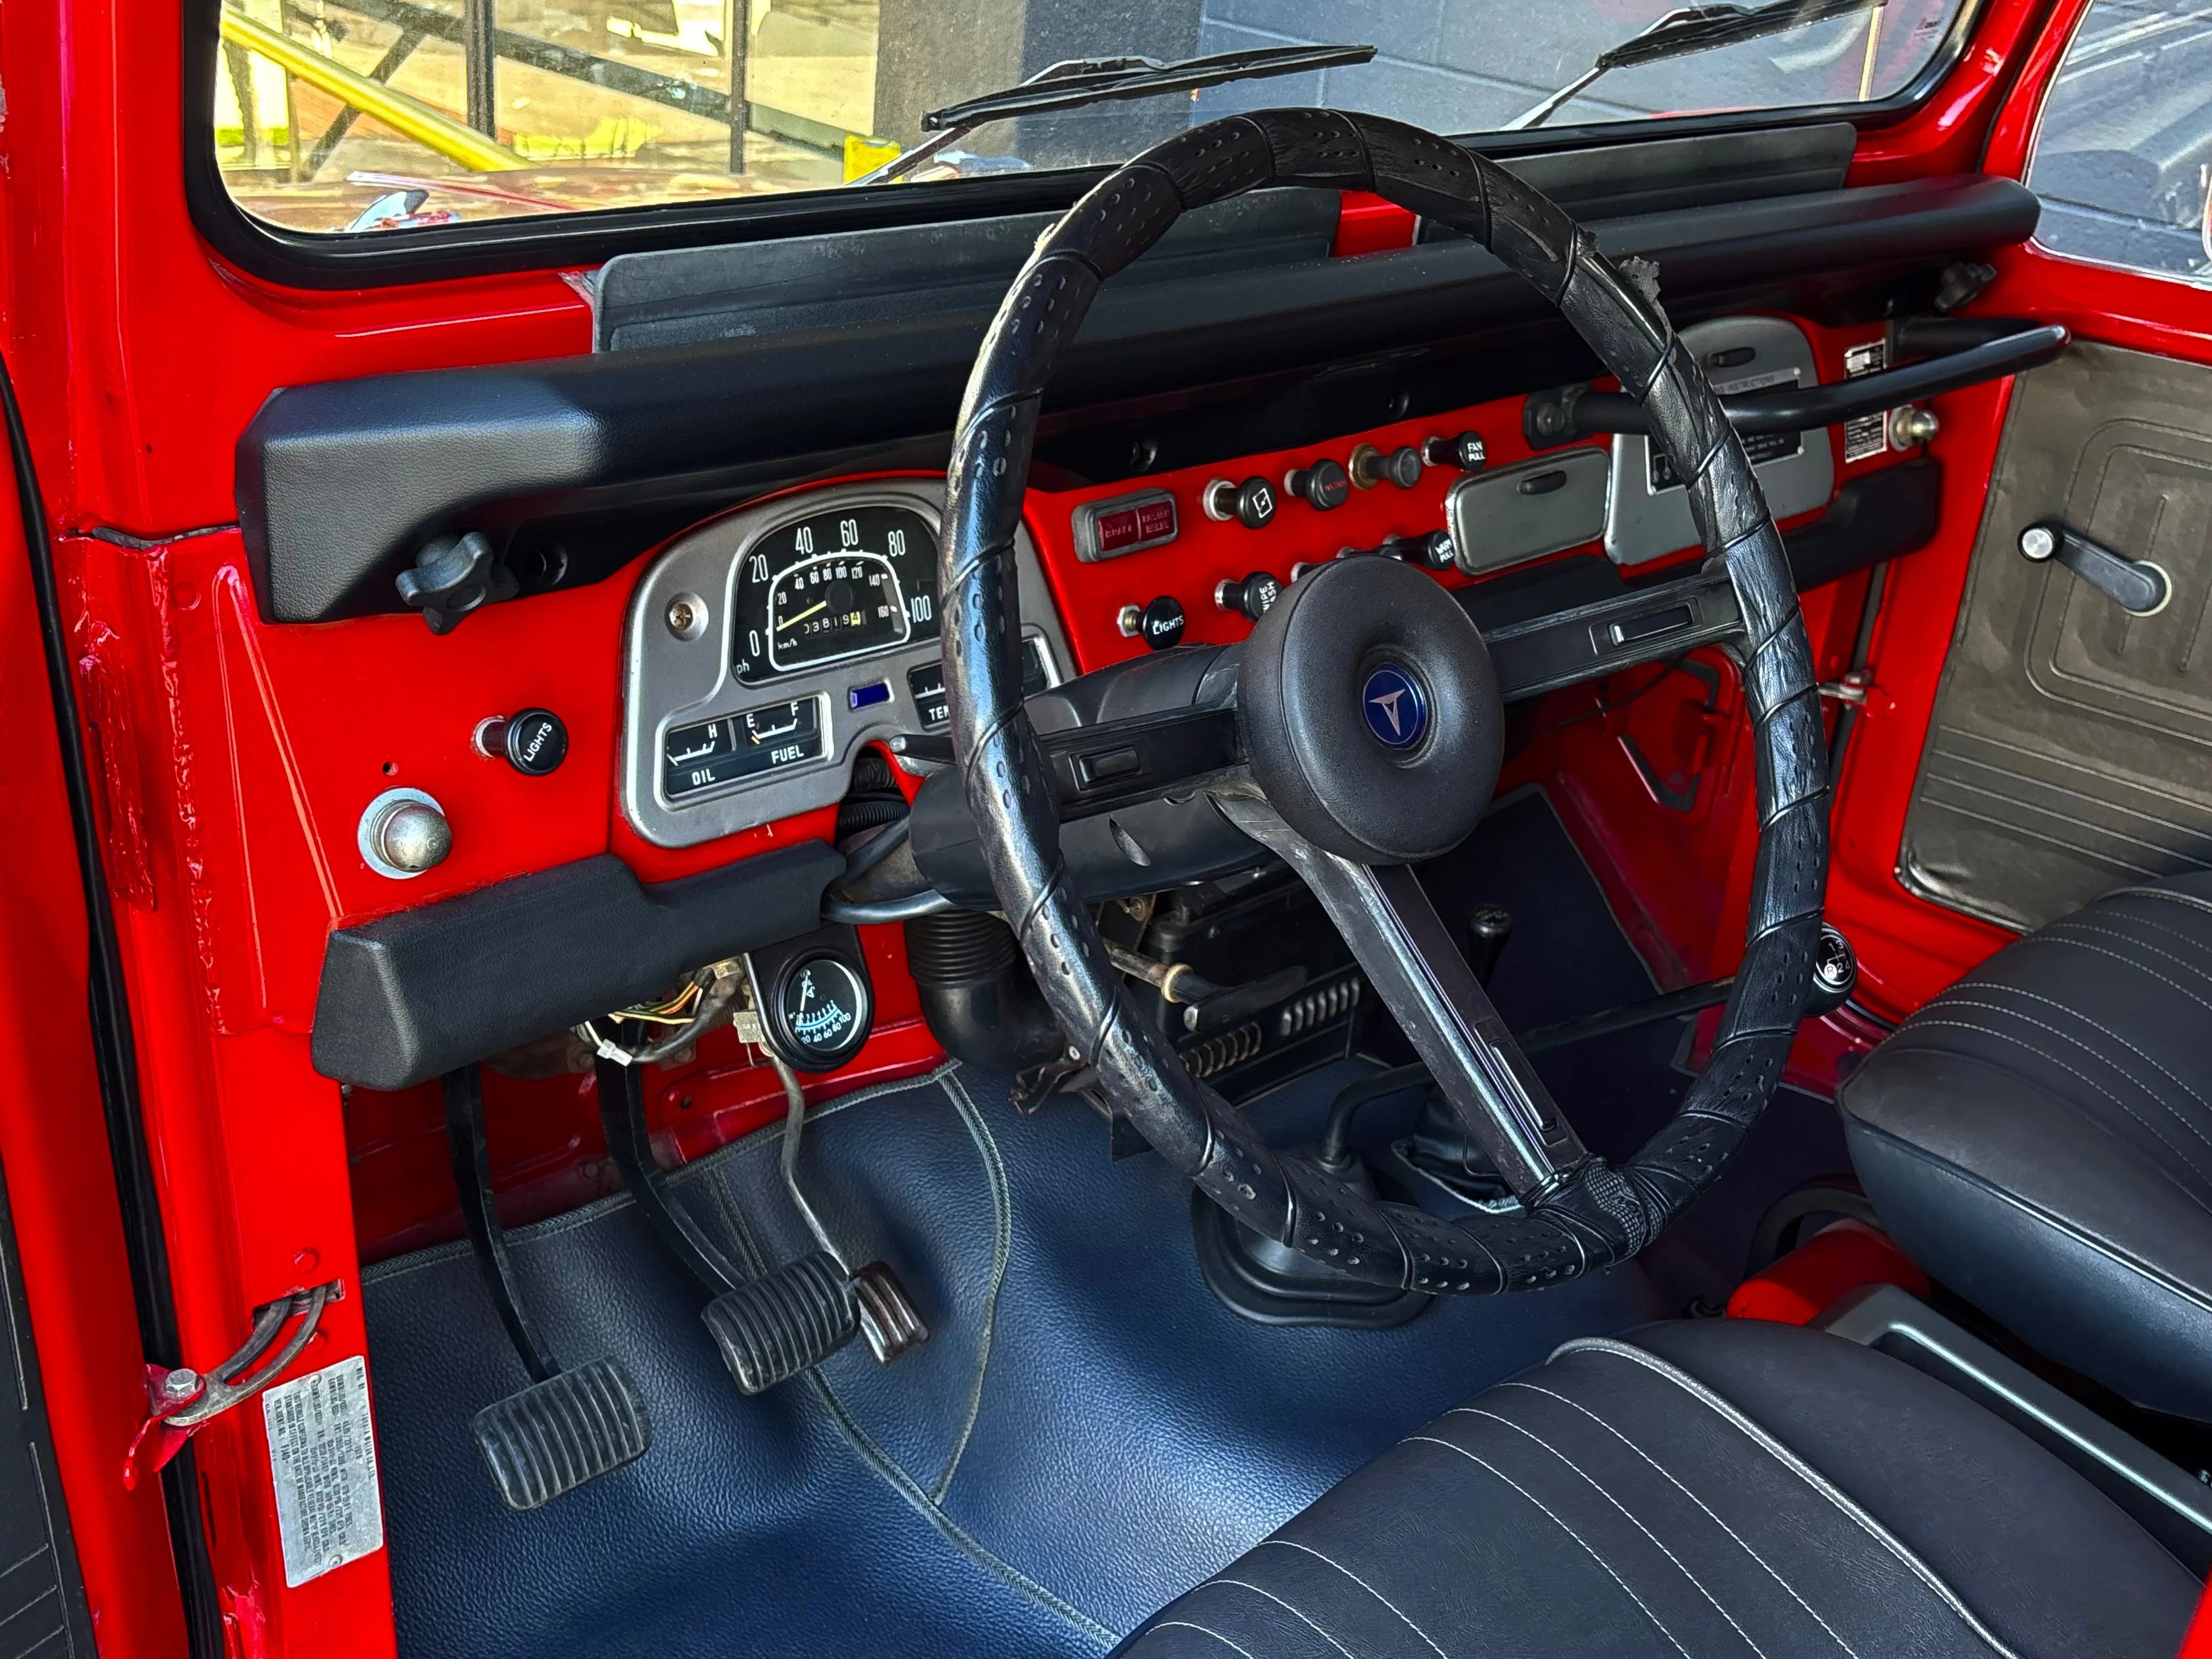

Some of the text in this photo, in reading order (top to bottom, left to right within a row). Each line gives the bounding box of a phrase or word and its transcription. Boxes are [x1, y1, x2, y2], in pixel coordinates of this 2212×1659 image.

[1467, 441, 1483, 453] FAN
[840, 519, 859, 547] 60
[795, 526, 814, 555] 40
[888, 529, 906, 557] 80
[749, 554, 769, 583] 20
[823, 568, 832, 581] 80
[835, 566, 847, 579] 100
[851, 566, 864, 579] 120
[795, 577, 805, 590] 40
[810, 571, 820, 584] 60
[869, 574, 881, 588] 140
[777, 591, 787, 605] 20
[1267, 581, 1277, 602] ASH
[878, 605, 889, 619] 160
[911, 595, 932, 623] 100
[1153, 616, 1184, 635] LIGHTS
[749, 630, 760, 657] 0
[777, 637, 798, 651] km/h
[736, 658, 750, 676] ph
[791, 702, 799, 716] F
[746, 713, 755, 728] E
[708, 724, 718, 738] H
[523, 723, 552, 762] LIGHTS
[771, 744, 804, 764] FUEL
[692, 768, 715, 786] OIL
[1829, 940, 1844, 952] 1 3
[1827, 966, 1835, 975] R
[1837, 963, 1844, 974] 2
[801, 1035, 811, 1045] 20
[814, 1032, 822, 1042] 40
[823, 1028, 833, 1039] 60
[838, 1012, 851, 1024] 100
